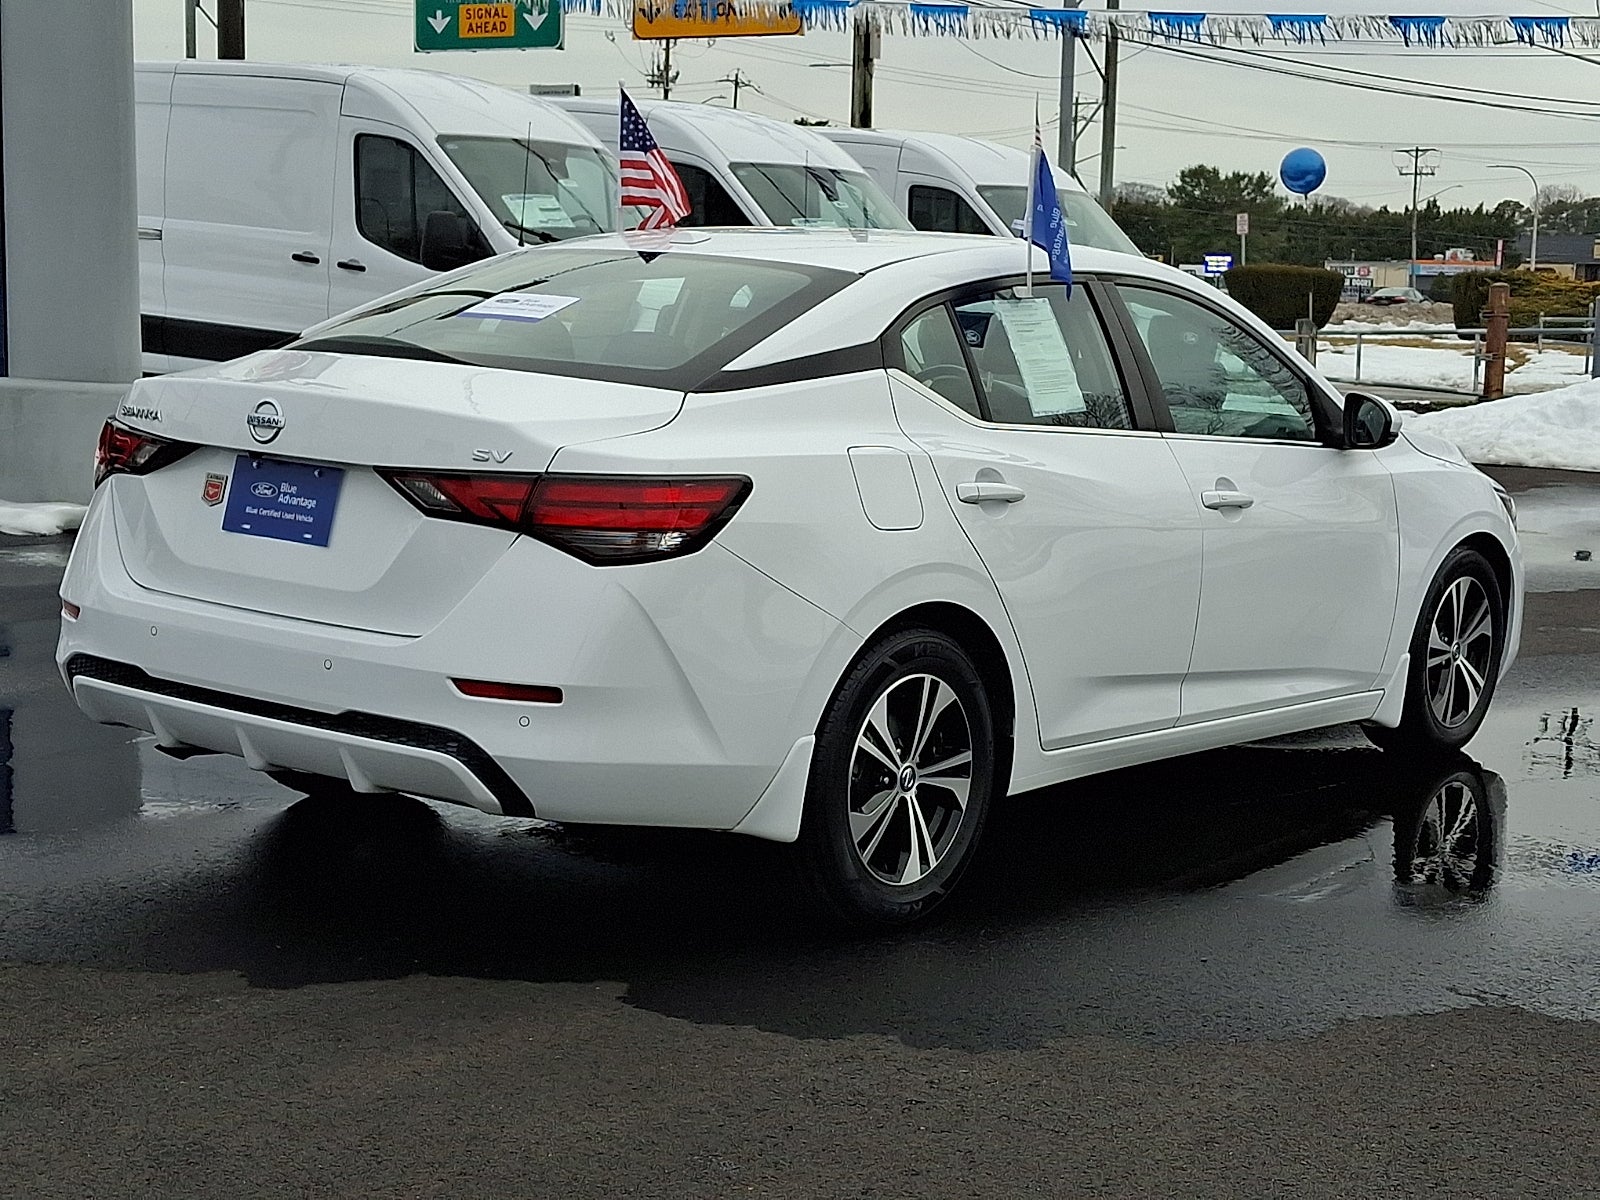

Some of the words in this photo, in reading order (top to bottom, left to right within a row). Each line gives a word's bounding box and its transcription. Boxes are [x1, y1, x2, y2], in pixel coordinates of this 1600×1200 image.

[465, 7, 508, 20] SIGNAL
[466, 21, 507, 34] AHEAD
[248, 414, 281, 426] NISSAN
[472, 448, 513, 464] SV
[255, 484, 274, 496] Ford
[280, 482, 298, 493] Blue
[277, 493, 317, 508] Advantage
[245, 506, 258, 514] Blue
[259, 507, 281, 518] Certified
[281, 511, 296, 520] Used
[295, 513, 314, 523] Vehicle
